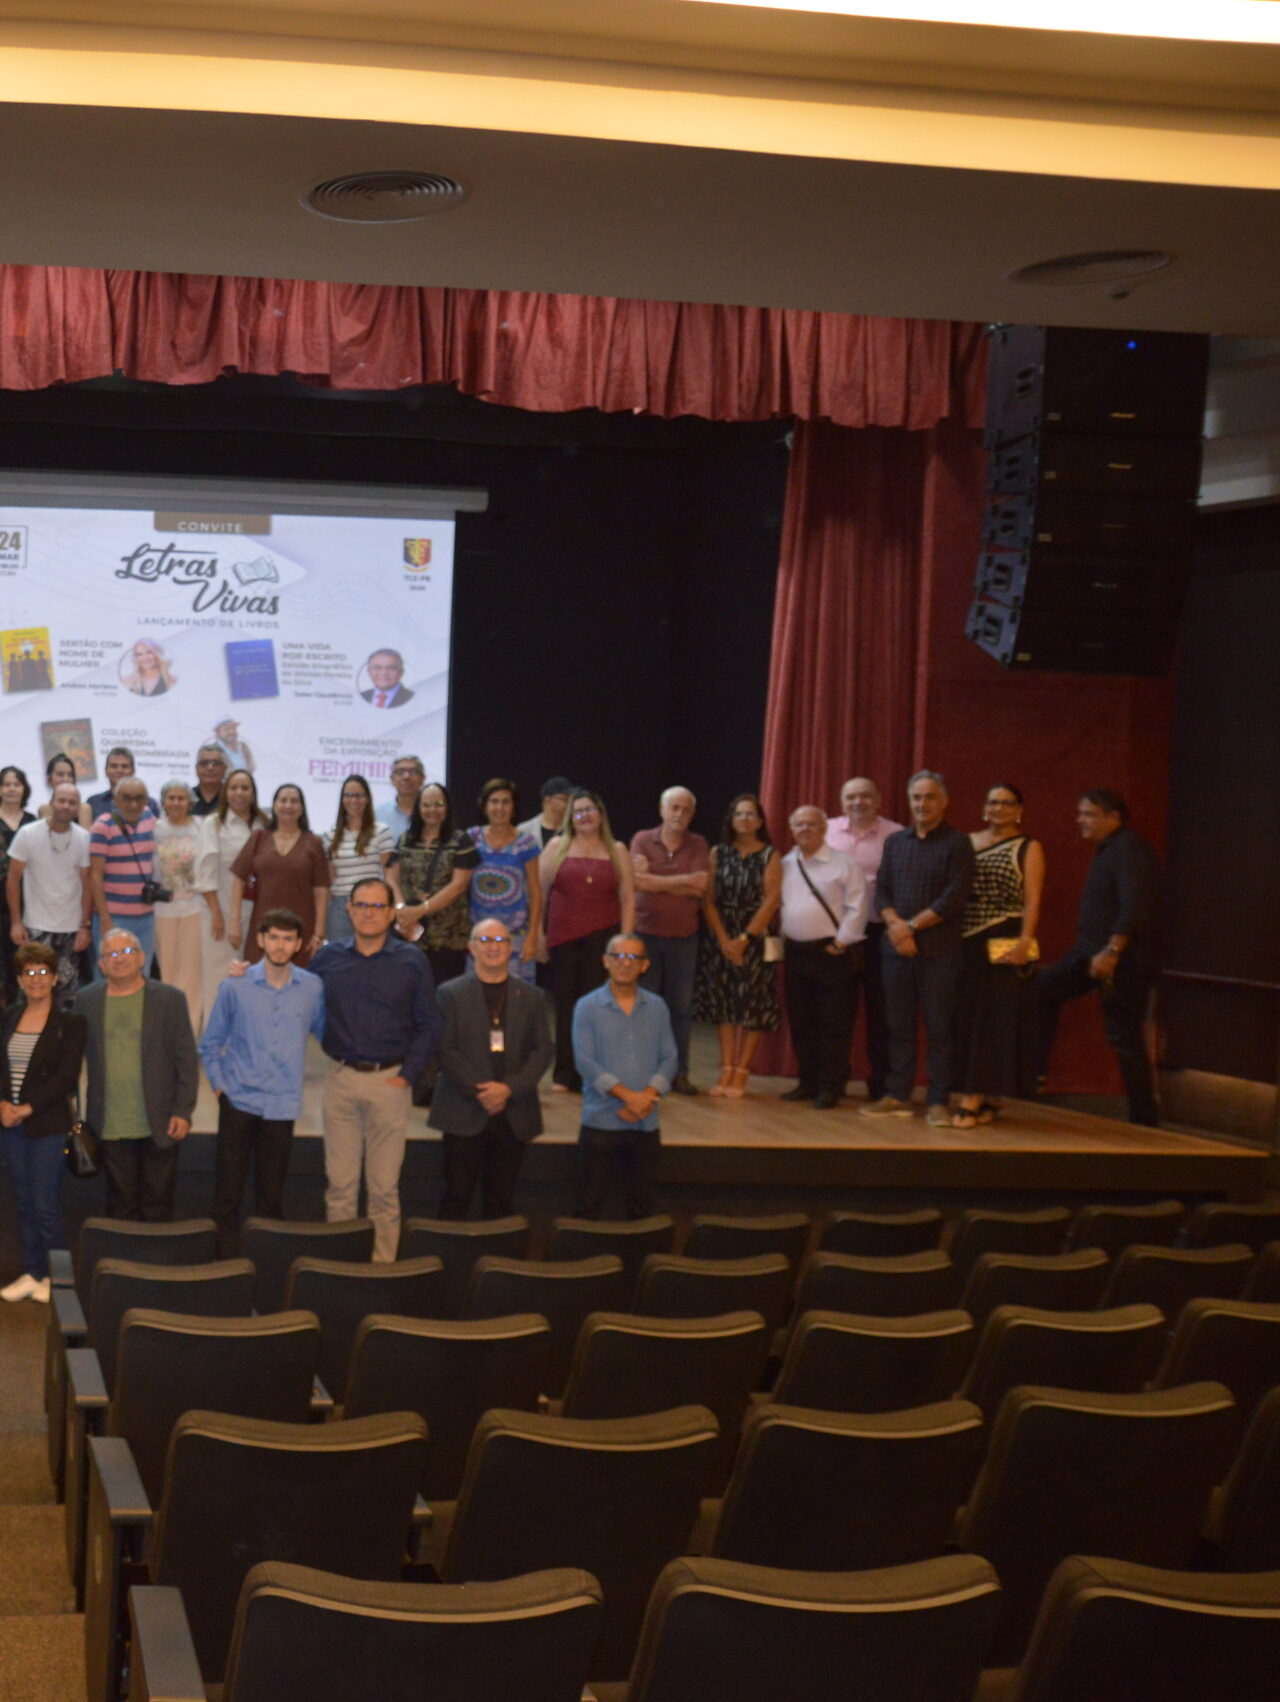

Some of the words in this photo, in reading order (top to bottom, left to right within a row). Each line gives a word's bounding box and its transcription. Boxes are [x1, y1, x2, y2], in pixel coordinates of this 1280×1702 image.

[177, 521, 244, 534] CONVITE
[114, 542, 218, 583] Letras
[172, 579, 280, 615] Vivas
[137, 617, 217, 629] LANÇAMENTO
[219, 619, 236, 628] DE
[238, 620, 280, 630] LIVROS
[60, 649, 89, 658] NOME
[91, 650, 105, 659] DE
[59, 659, 101, 669] MULHER
